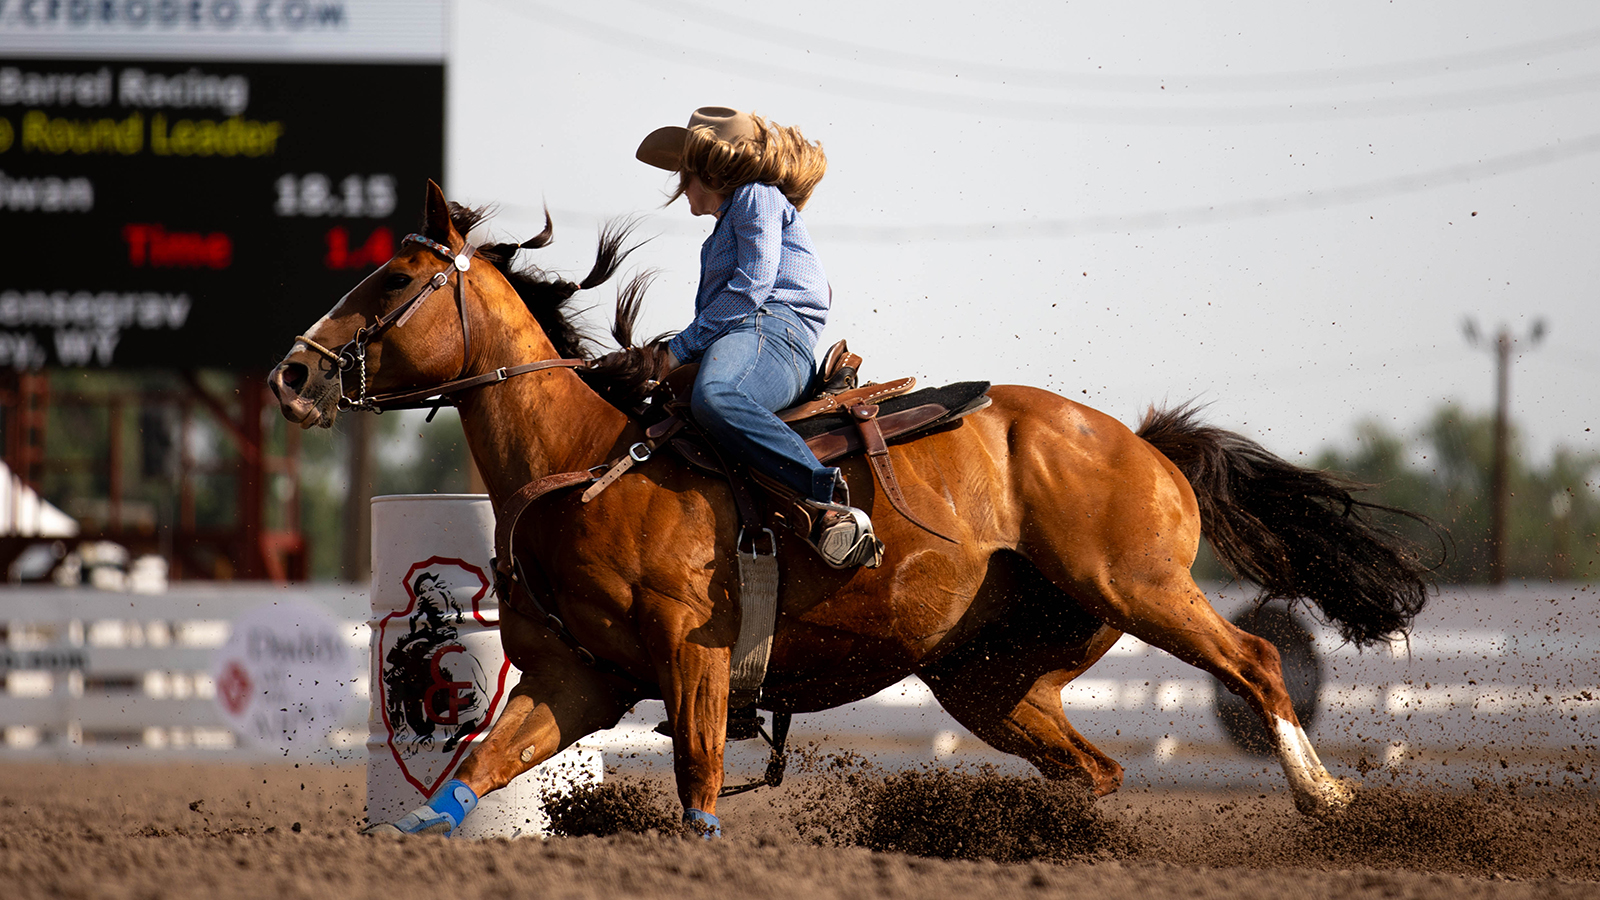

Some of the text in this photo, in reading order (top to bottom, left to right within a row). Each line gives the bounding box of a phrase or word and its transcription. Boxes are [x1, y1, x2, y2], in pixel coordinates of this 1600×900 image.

[0, 67, 249, 115] Barrel Racing
[22, 112, 144, 155] Round
[150, 114, 282, 157] Leader
[275, 173, 396, 217] 18.15
[124, 223, 232, 268] Time
[54, 331, 121, 367] WY
